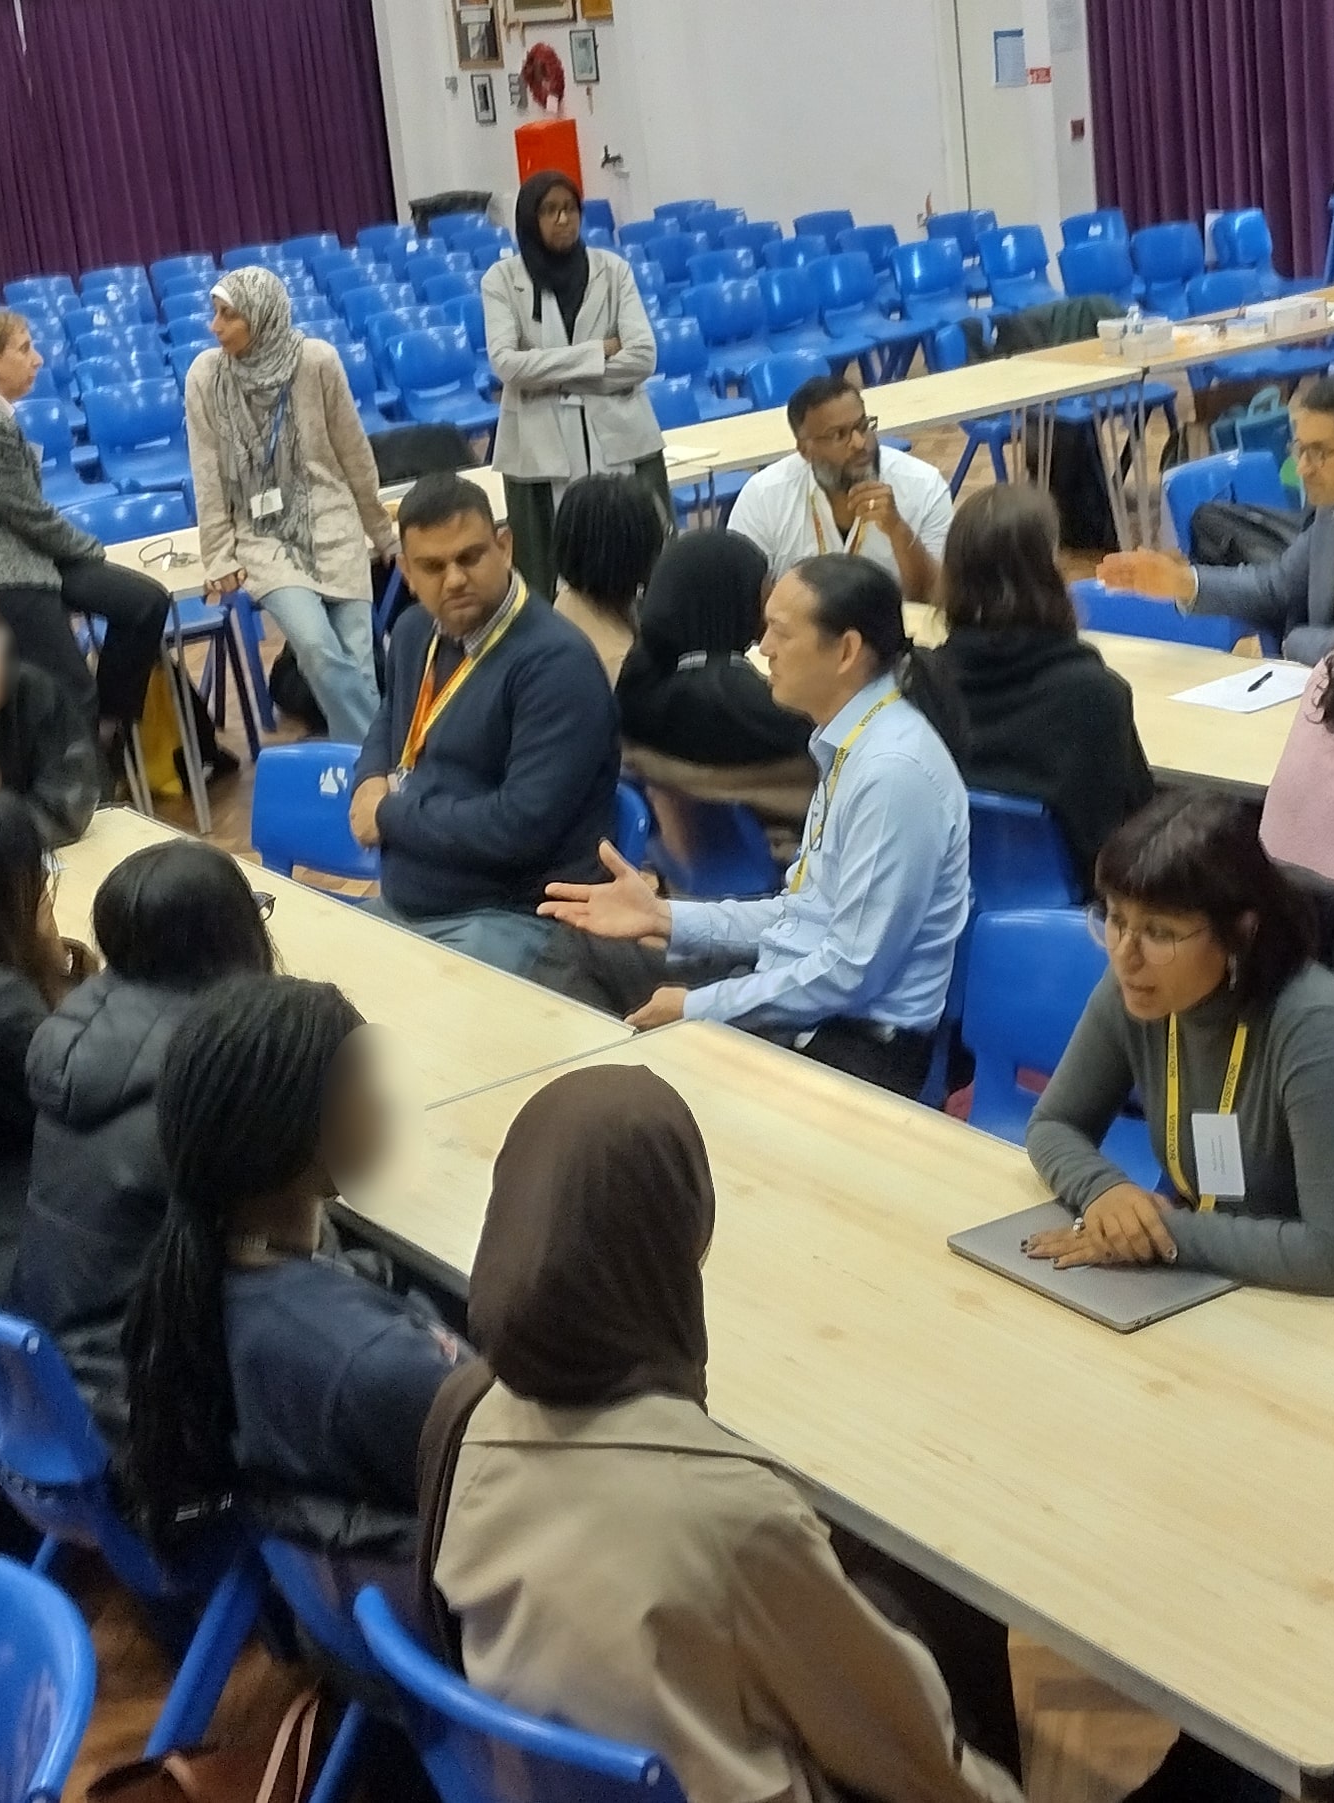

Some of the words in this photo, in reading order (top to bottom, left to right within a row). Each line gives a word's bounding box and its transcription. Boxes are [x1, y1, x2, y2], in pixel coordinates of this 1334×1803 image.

[858, 701, 886, 728] VISITOR
[1221, 1062, 1238, 1109] VISITOR
[1168, 1114, 1177, 1161] VISITOR
